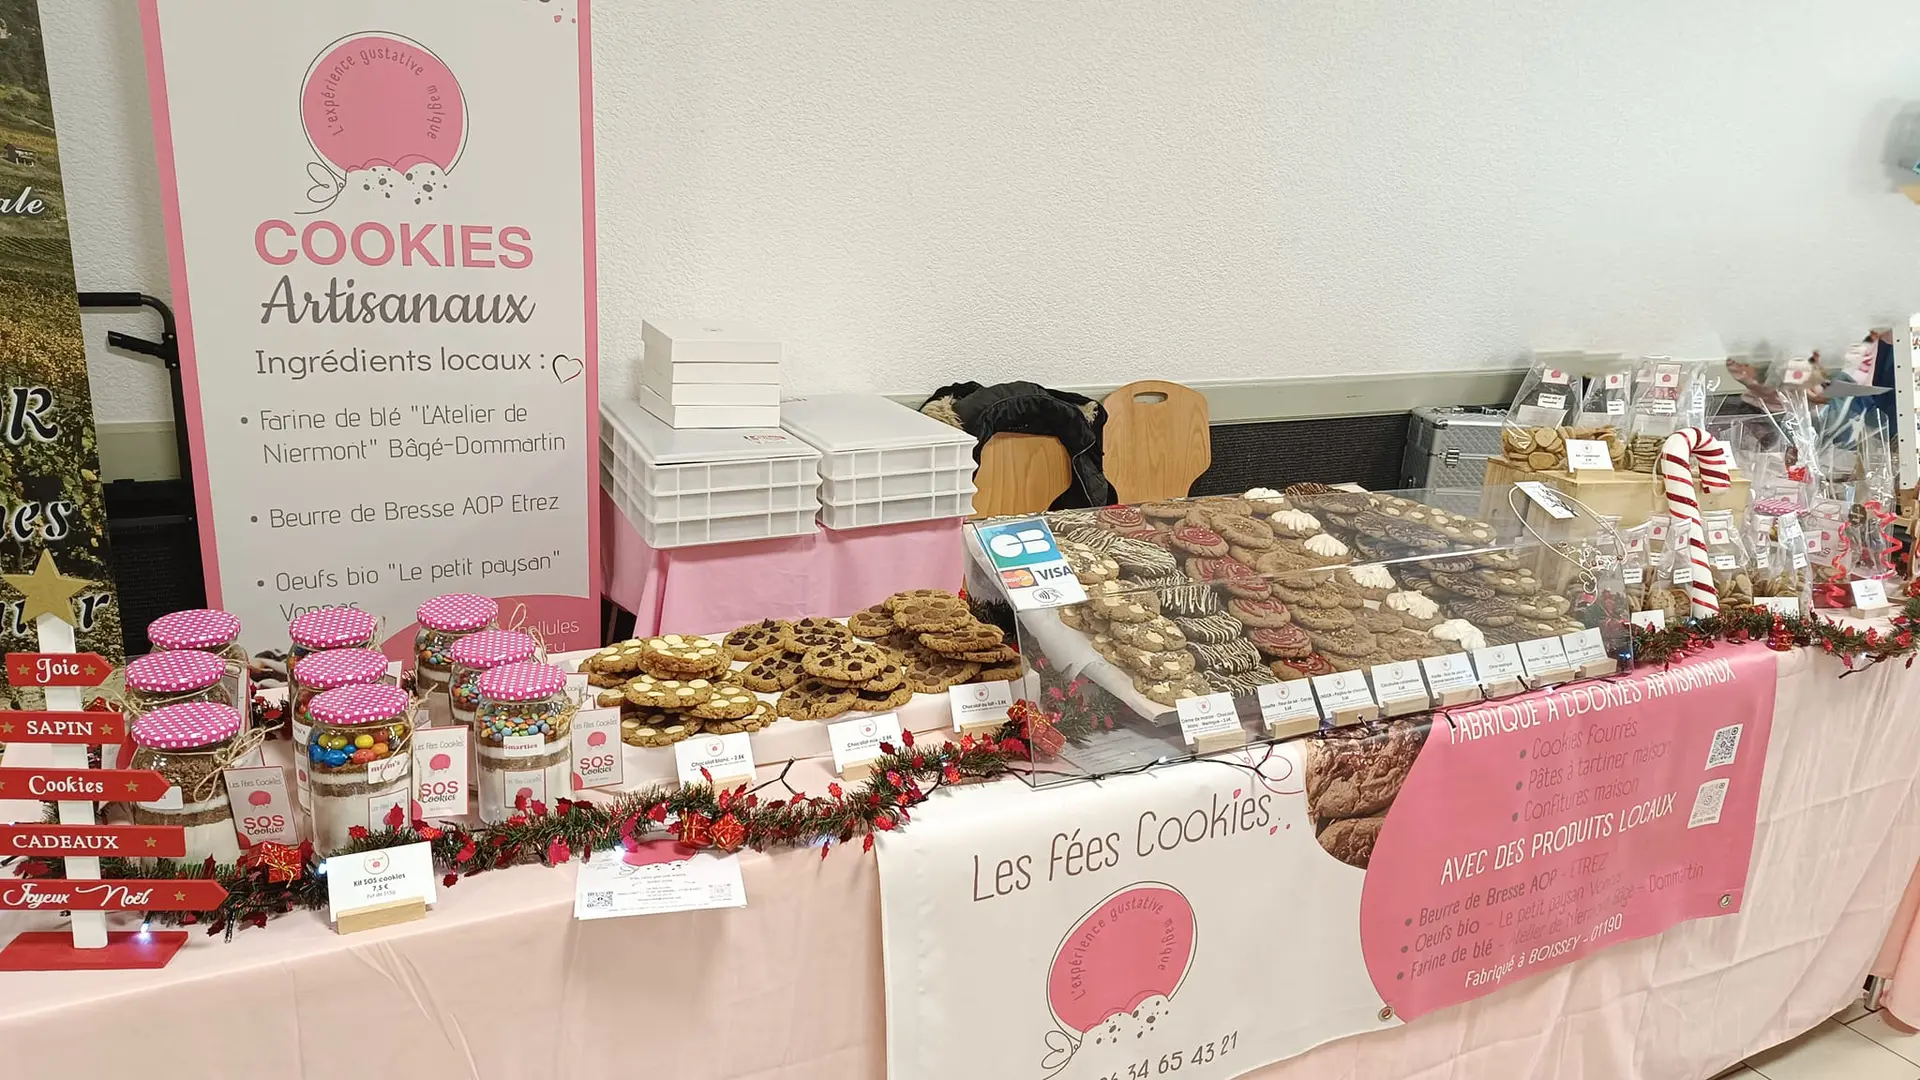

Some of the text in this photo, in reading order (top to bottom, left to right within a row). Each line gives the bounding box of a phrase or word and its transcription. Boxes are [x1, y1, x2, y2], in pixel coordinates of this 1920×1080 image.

[321, 47, 447, 140] L'expérience gustative magique
[254, 219, 535, 269] COOKIES
[261, 274, 536, 325] Artisanaux
[255, 346, 432, 380] Ingrédients
[440, 346, 531, 372] locaux
[260, 404, 528, 430] Farine de blé "L'Atelier de
[264, 433, 566, 464] Niermont" Bâgé-Dommartin
[0, 501, 72, 541] es
[270, 494, 560, 529] Beurre de Bresse AOP Etrez
[276, 550, 561, 592] Oeufs bio "Le petit paysan"
[1035, 565, 1073, 580] VISA
[36, 658, 80, 683] Joie
[27, 720, 93, 737] SAPIN
[1449, 700, 1540, 745] FABRIQUE
[1561, 681, 1642, 716] COOKIES
[580, 754, 614, 769] SOS
[1532, 731, 1583, 760] Cookies
[581, 766, 612, 776] Cookies
[1529, 739, 1673, 791] Pâtes à tartiner maison
[28, 775, 104, 795] Cookies
[421, 781, 458, 797] SOS
[421, 793, 456, 804] Cookies
[1524, 777, 1640, 822] Confitures maison
[243, 815, 285, 830] SOS
[247, 826, 284, 836] Cookies
[1441, 792, 1677, 886] AVEC DES PRODUITS LOCAUX
[12, 834, 119, 850] CADEAUX
[973, 854, 1032, 902] Les
[1137, 789, 1272, 857] Cookies
[3, 883, 154, 909] Joyeux Noël
[364, 877, 377, 885] SOS
[379, 873, 406, 882] cookies
[1419, 900, 1460, 927] Beurre
[1465, 893, 1481, 910] de
[1486, 882, 1525, 906] Bresse
[1530, 868, 1558, 894] AOP
[1415, 925, 1453, 952] Oeufs
[1457, 917, 1480, 937] bio
[1500, 910, 1513, 928] Le
[1517, 899, 1545, 924] petit
[1549, 886, 1584, 916] paysan
[1069, 896, 1176, 1001] L'expérience gustative magique
[1411, 953, 1446, 981] Farine
[1451, 945, 1467, 964] de
[1473, 938, 1493, 959] blé
[1549, 919, 1561, 935] de
[1465, 955, 1515, 988] Fabriqué
[1517, 952, 1525, 968] à
[1528, 934, 1581, 965] BOISSEY
[1590, 913, 1623, 942] 01190
[1128, 1031, 1238, 1080] 34 65 43 21
